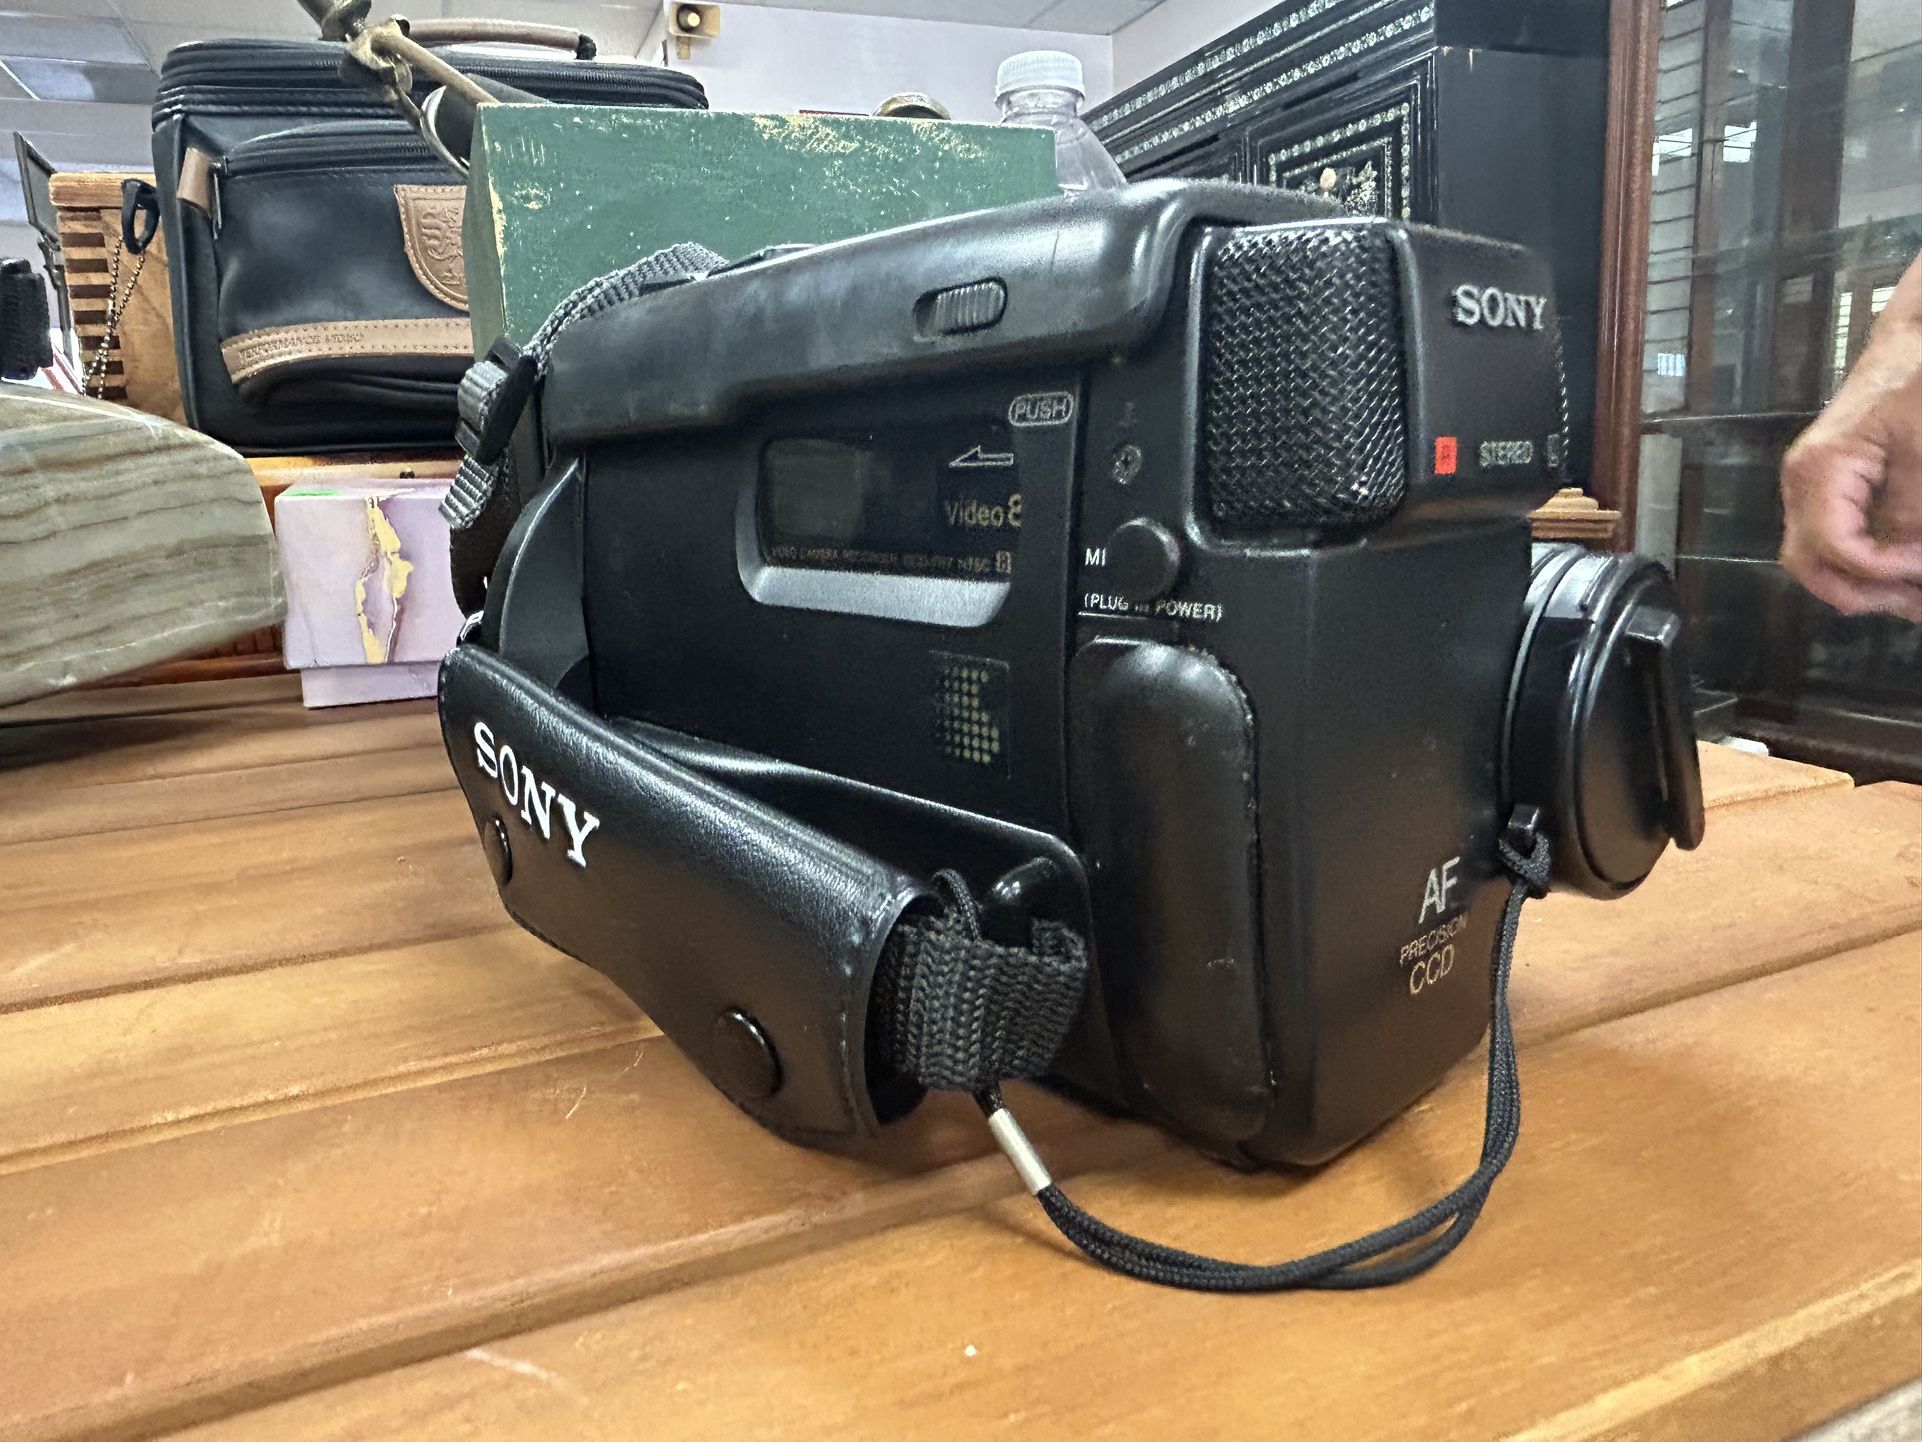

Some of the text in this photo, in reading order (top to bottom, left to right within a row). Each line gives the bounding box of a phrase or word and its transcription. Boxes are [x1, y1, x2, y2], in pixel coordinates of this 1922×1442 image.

[1453, 284, 1547, 329] SONY
[1015, 398, 1067, 419] PUSH
[1155, 601, 1223, 622] POWER)
[474, 721, 600, 868] SONY
[1418, 856, 1461, 924] AF
[1400, 914, 1469, 967] PRECISION
[1409, 944, 1455, 995] CCD
